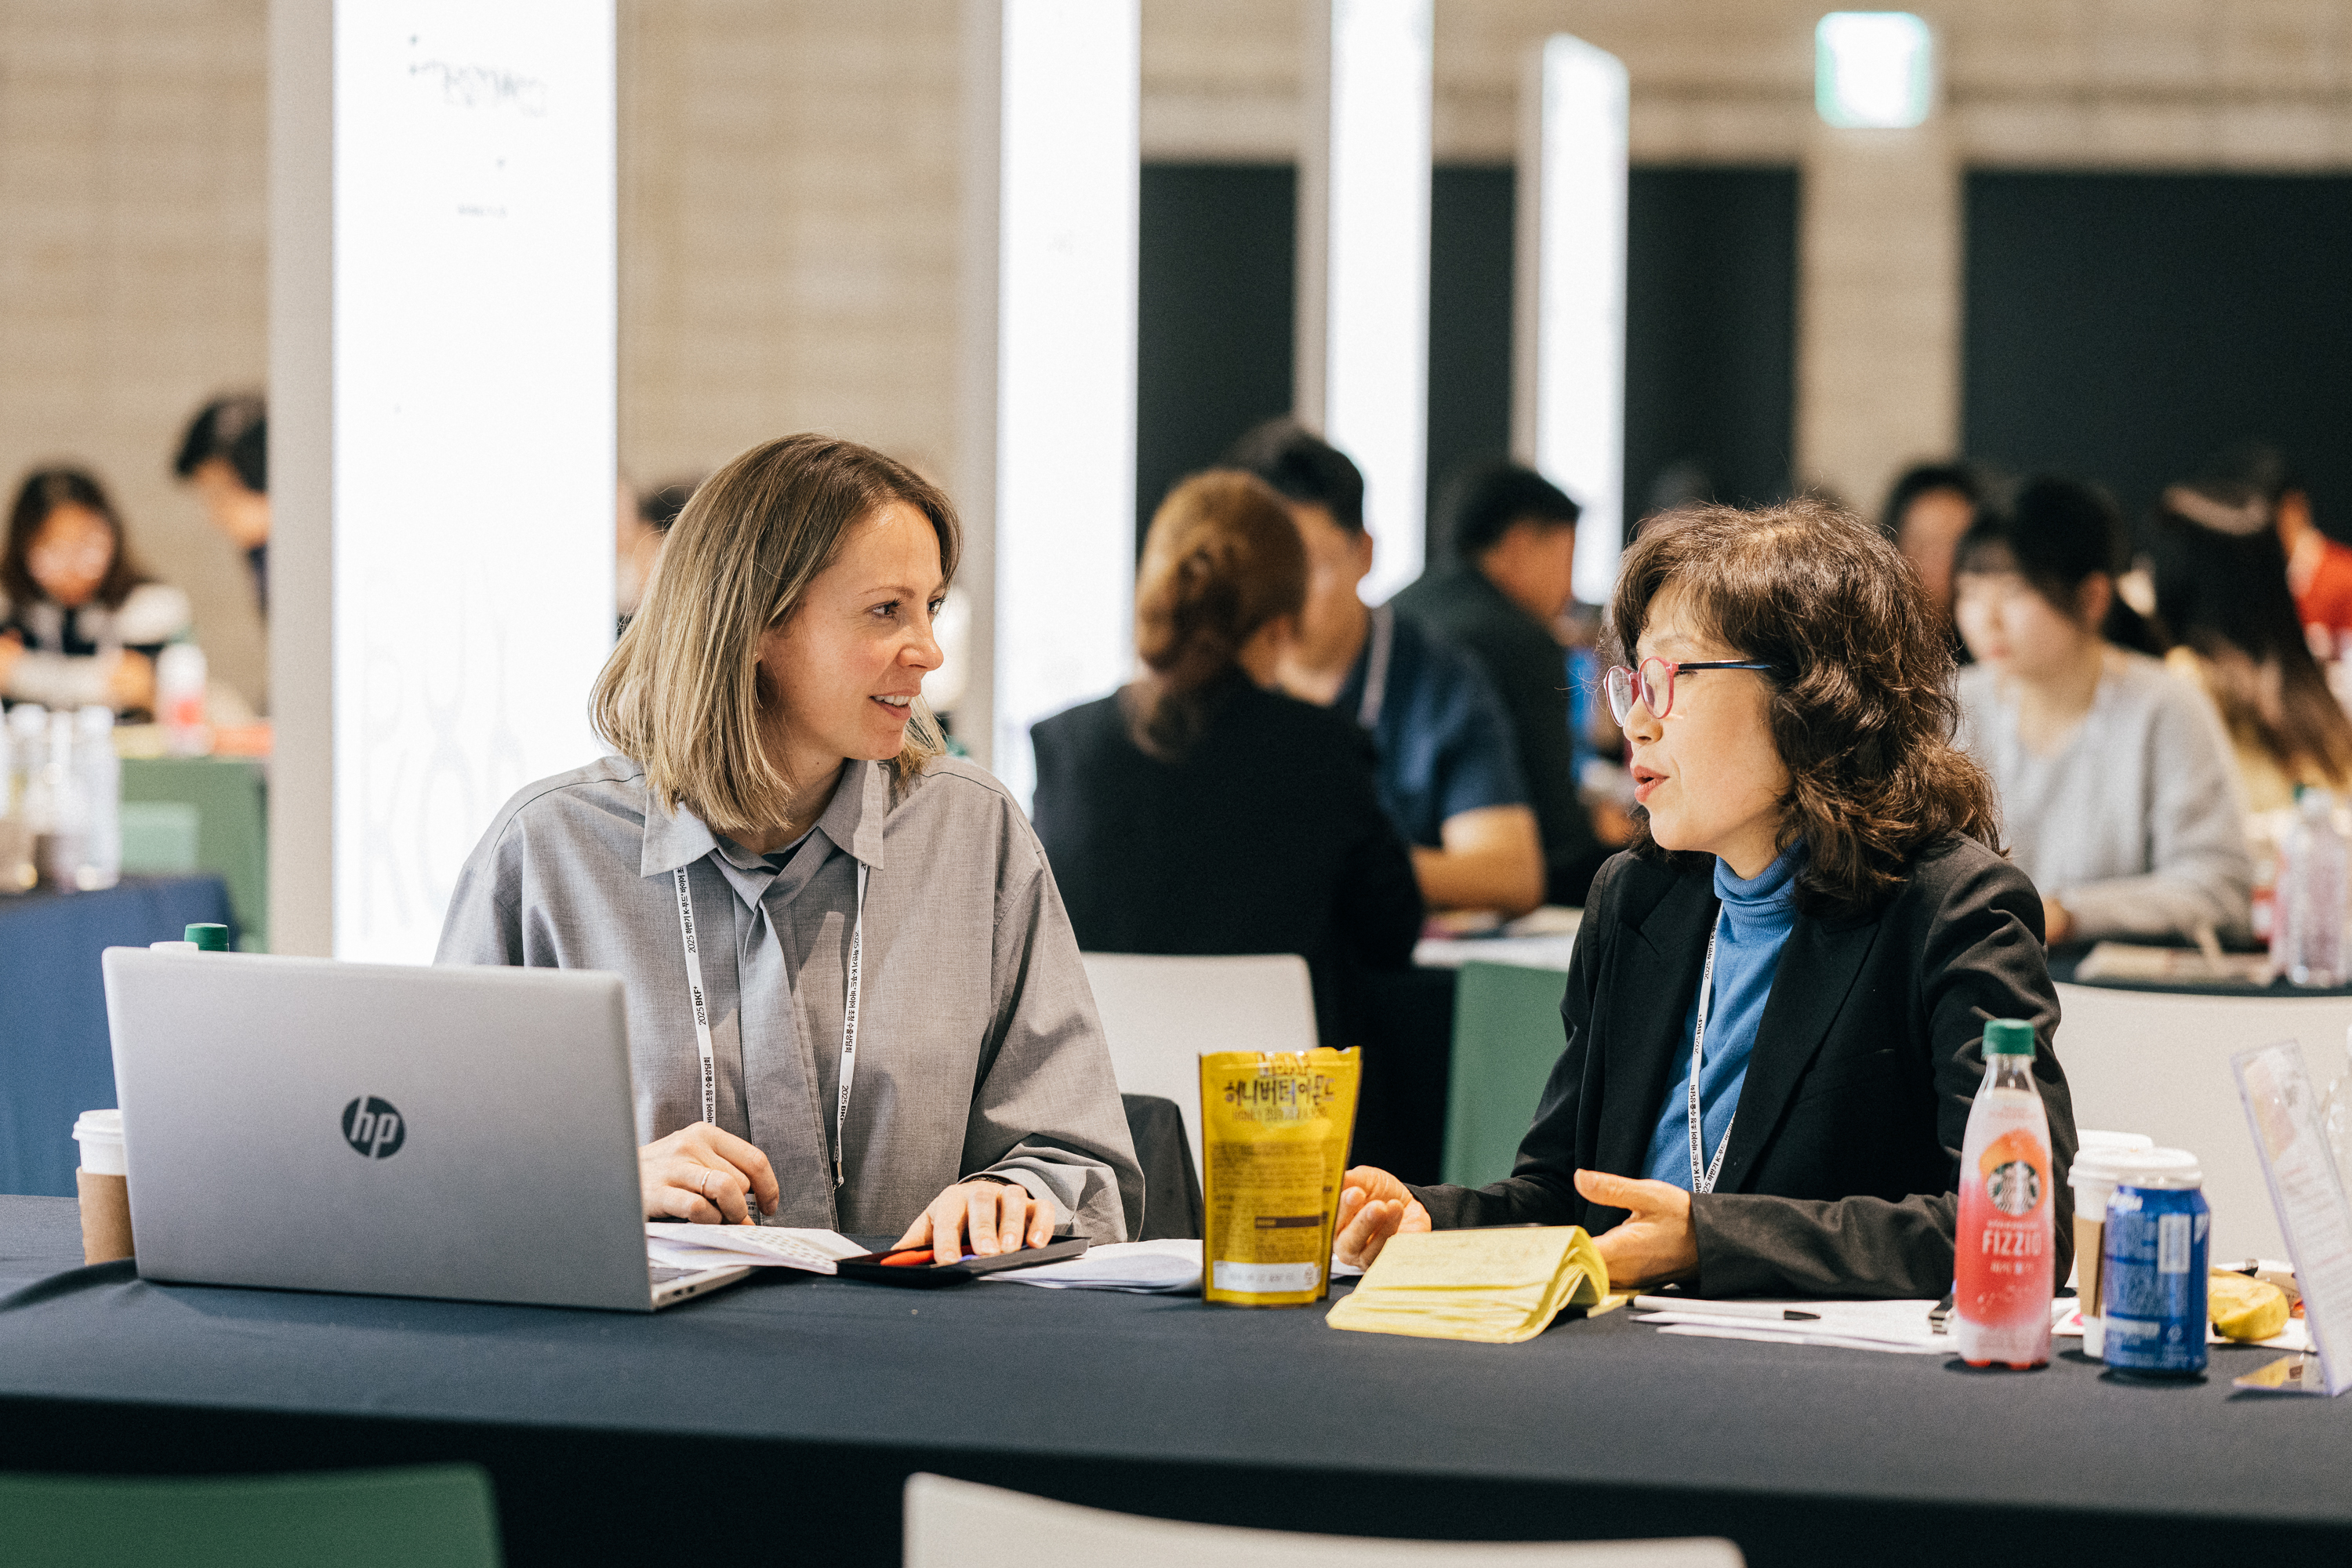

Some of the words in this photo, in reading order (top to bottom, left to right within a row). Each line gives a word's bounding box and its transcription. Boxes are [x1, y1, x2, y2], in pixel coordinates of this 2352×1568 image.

[677, 875, 688, 893] 바이어
[684, 916, 693, 935] 하반기
[687, 935, 696, 953] 2025
[848, 990, 857, 1008] 바이어
[696, 1007, 706, 1025] 2025
[847, 1009, 855, 1022] 초청
[844, 1022, 854, 1053] 수출상담회
[703, 1057, 713, 1088] 수출상담회
[705, 1090, 713, 1102] 초청
[706, 1104, 714, 1123] 바이어
[349, 1095, 400, 1159] hp
[1690, 1117, 1697, 1131] 초청
[1708, 1162, 1719, 1181] 하반기
[1982, 1229, 2042, 1256] FIZZIO
